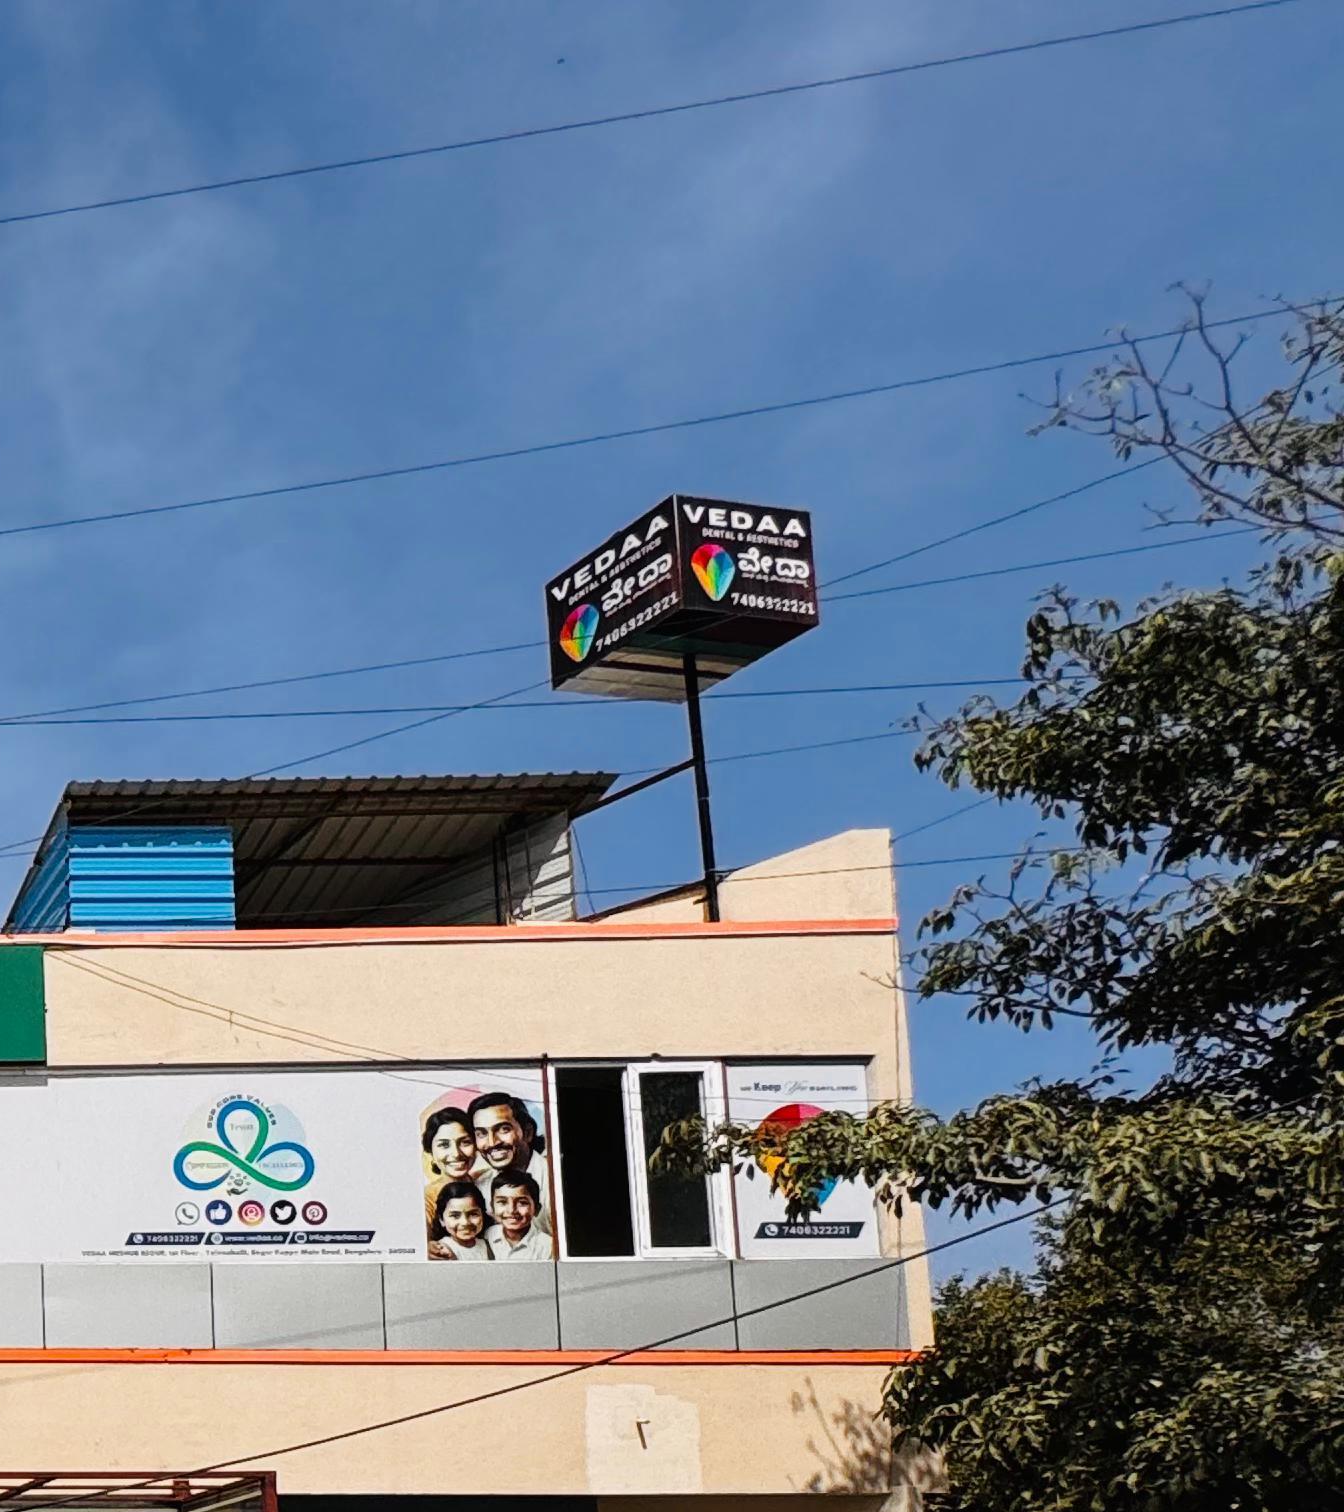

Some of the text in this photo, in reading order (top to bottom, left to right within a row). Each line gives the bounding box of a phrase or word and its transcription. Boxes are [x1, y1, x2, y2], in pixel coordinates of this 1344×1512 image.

[683, 504, 806, 538] VEDAA
[702, 528, 735, 542] DENTAL
[551, 515, 669, 602] VEDAA
[737, 547, 810, 579] ವೇದಾ
[601, 553, 673, 612] ವೇದಾ
[731, 592, 816, 615] 7406322221
